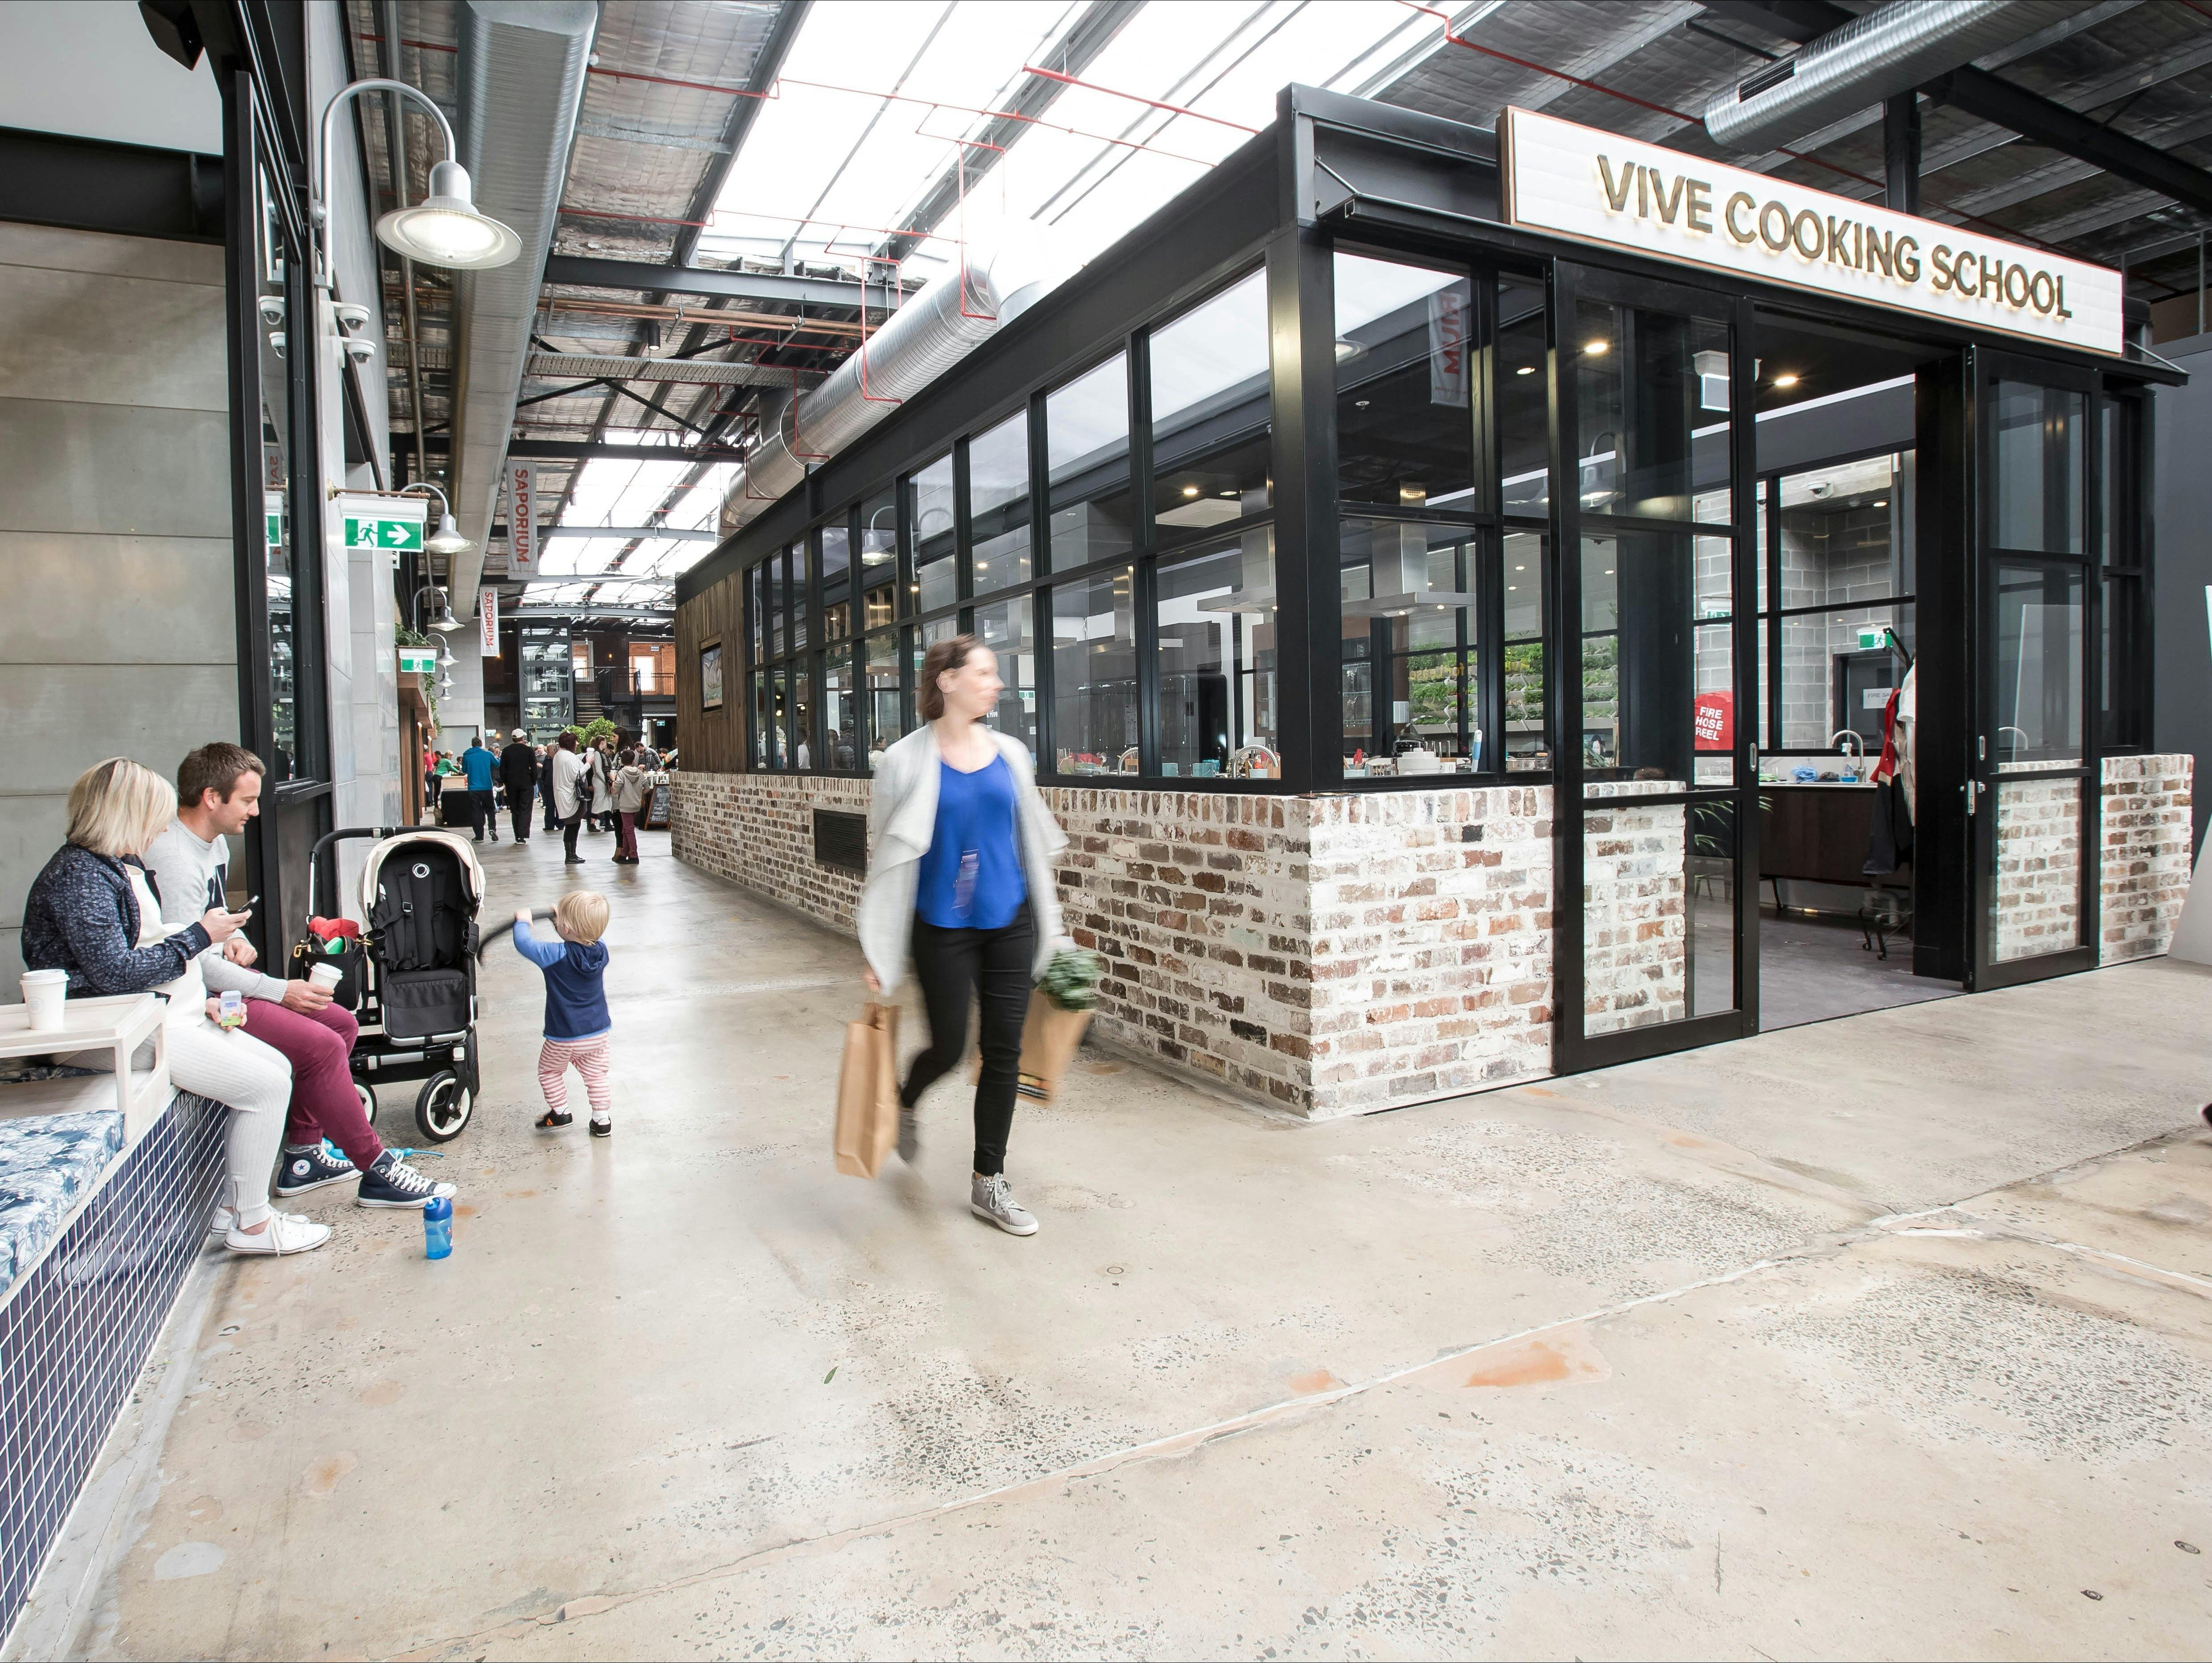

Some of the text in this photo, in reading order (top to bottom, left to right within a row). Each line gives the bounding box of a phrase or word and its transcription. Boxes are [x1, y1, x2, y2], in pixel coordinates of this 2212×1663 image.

[1597, 154, 2072, 318] VIVE COOKING SCHOOL
[515, 469, 530, 562] SAPORIUM
[484, 592, 494, 646] SAPORIUM
[1695, 716, 1724, 730] HOSE
[1700, 706, 1723, 719] FIRE
[1695, 727, 1719, 741] REEL
